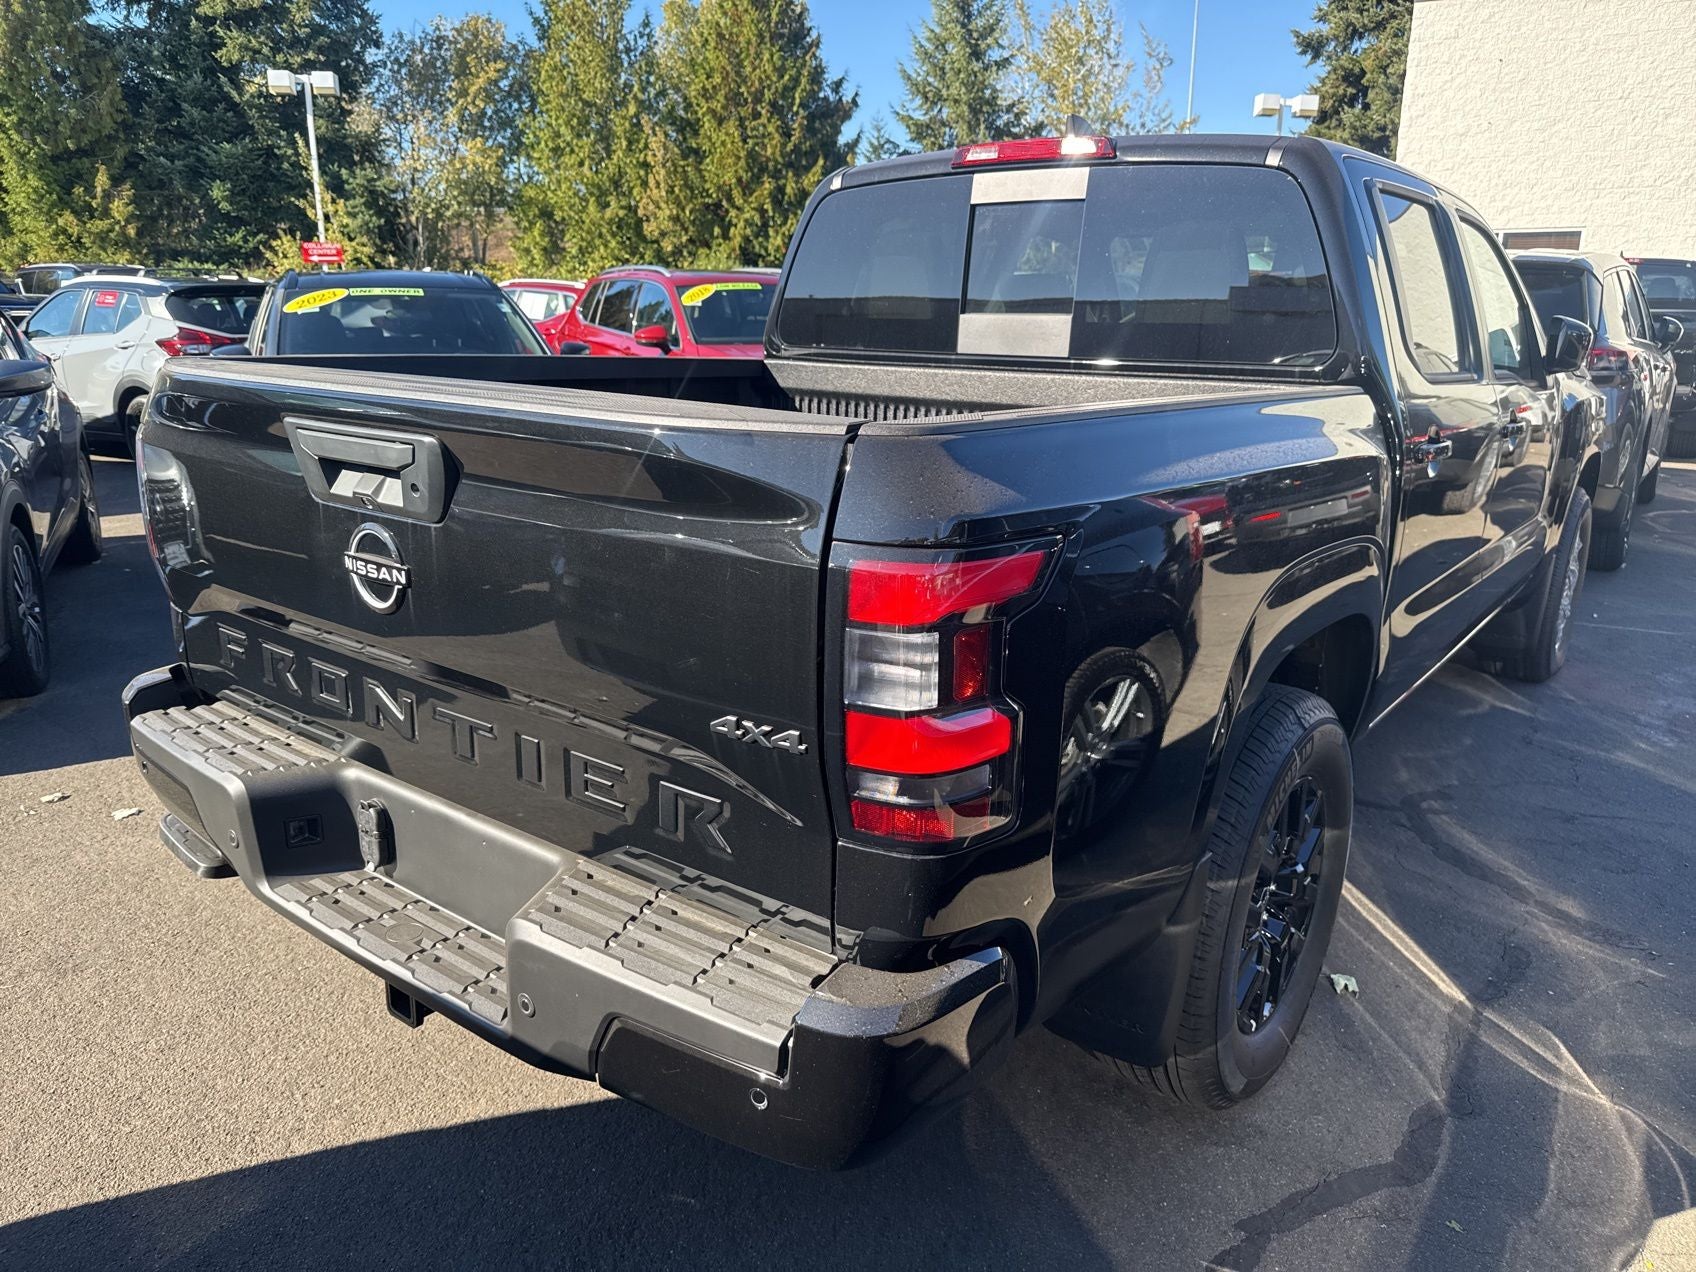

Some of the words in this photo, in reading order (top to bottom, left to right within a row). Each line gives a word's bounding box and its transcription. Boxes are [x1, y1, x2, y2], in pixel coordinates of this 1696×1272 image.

[296, 290, 338, 308] 2023
[344, 555, 406, 584] NISSAN
[217, 623, 734, 856] FRONTIER
